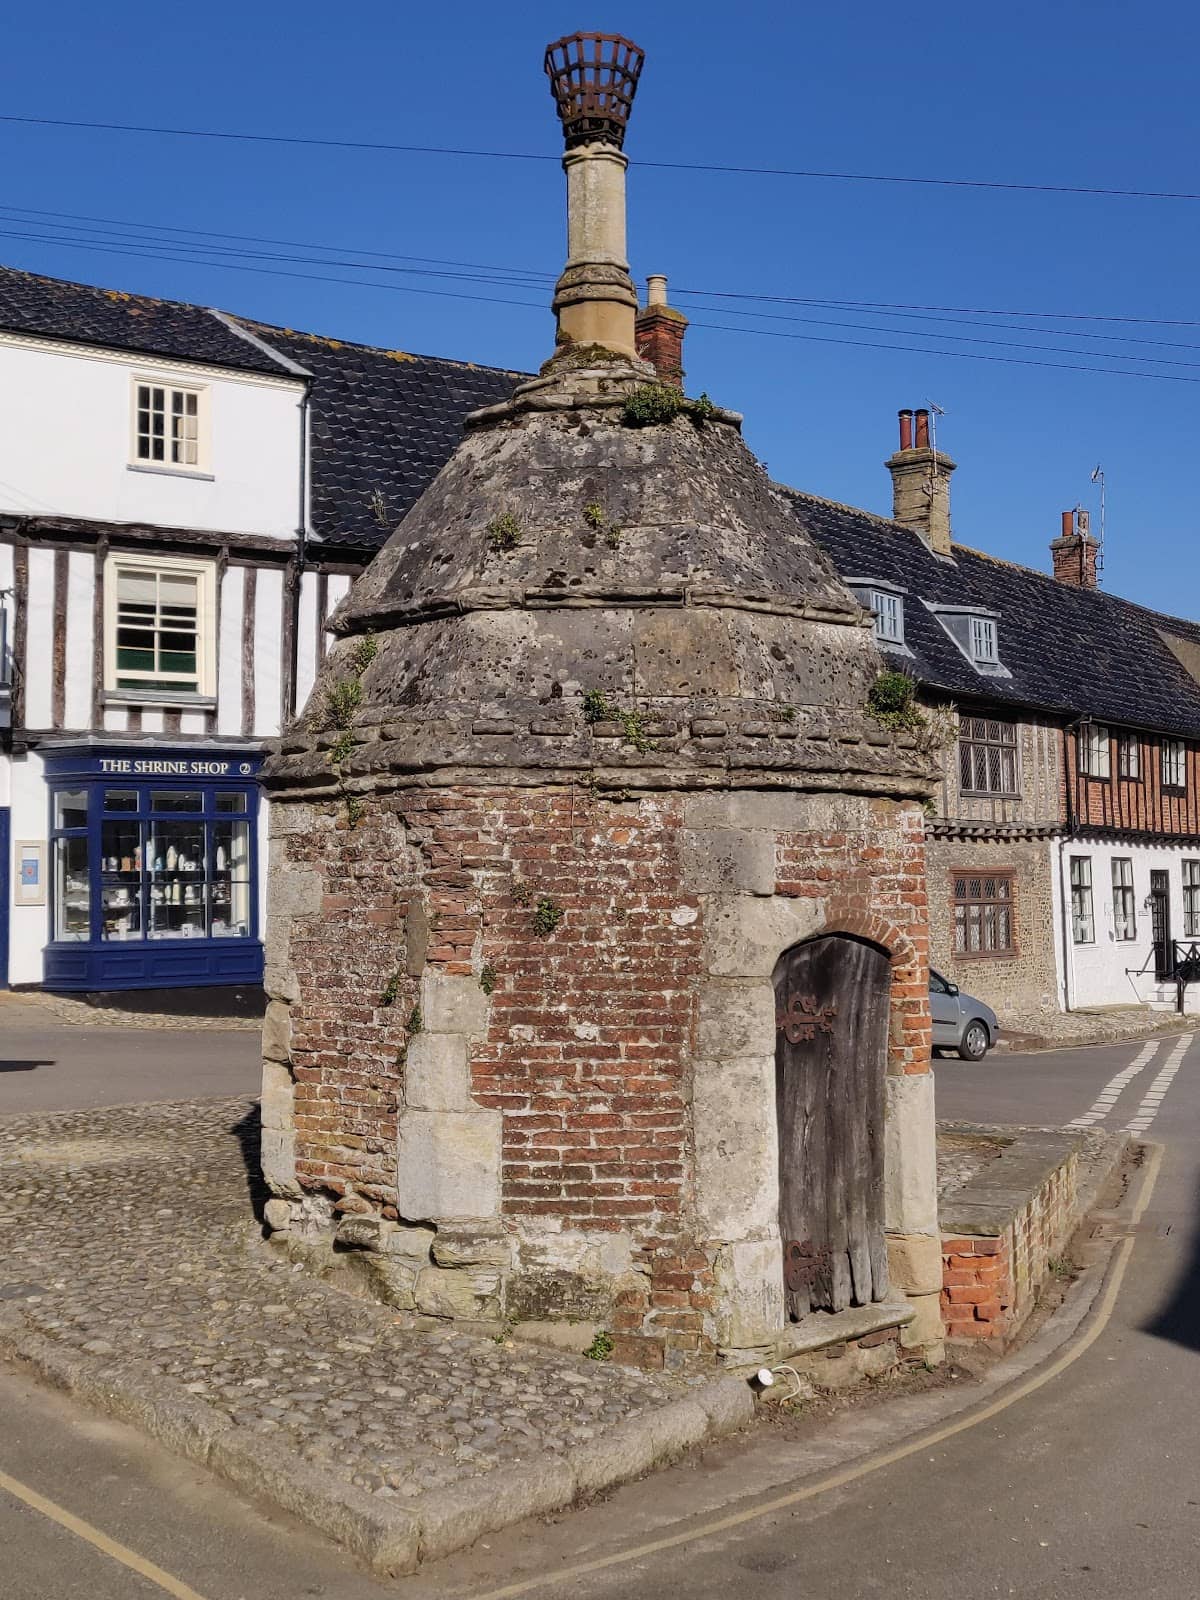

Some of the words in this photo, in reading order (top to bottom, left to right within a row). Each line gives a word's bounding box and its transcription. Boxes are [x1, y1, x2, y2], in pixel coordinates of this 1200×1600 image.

[100, 760, 131, 772] THE
[134, 760, 187, 773] SHRINE
[190, 761, 228, 774] SHOP
[241, 764, 250, 774] 2
